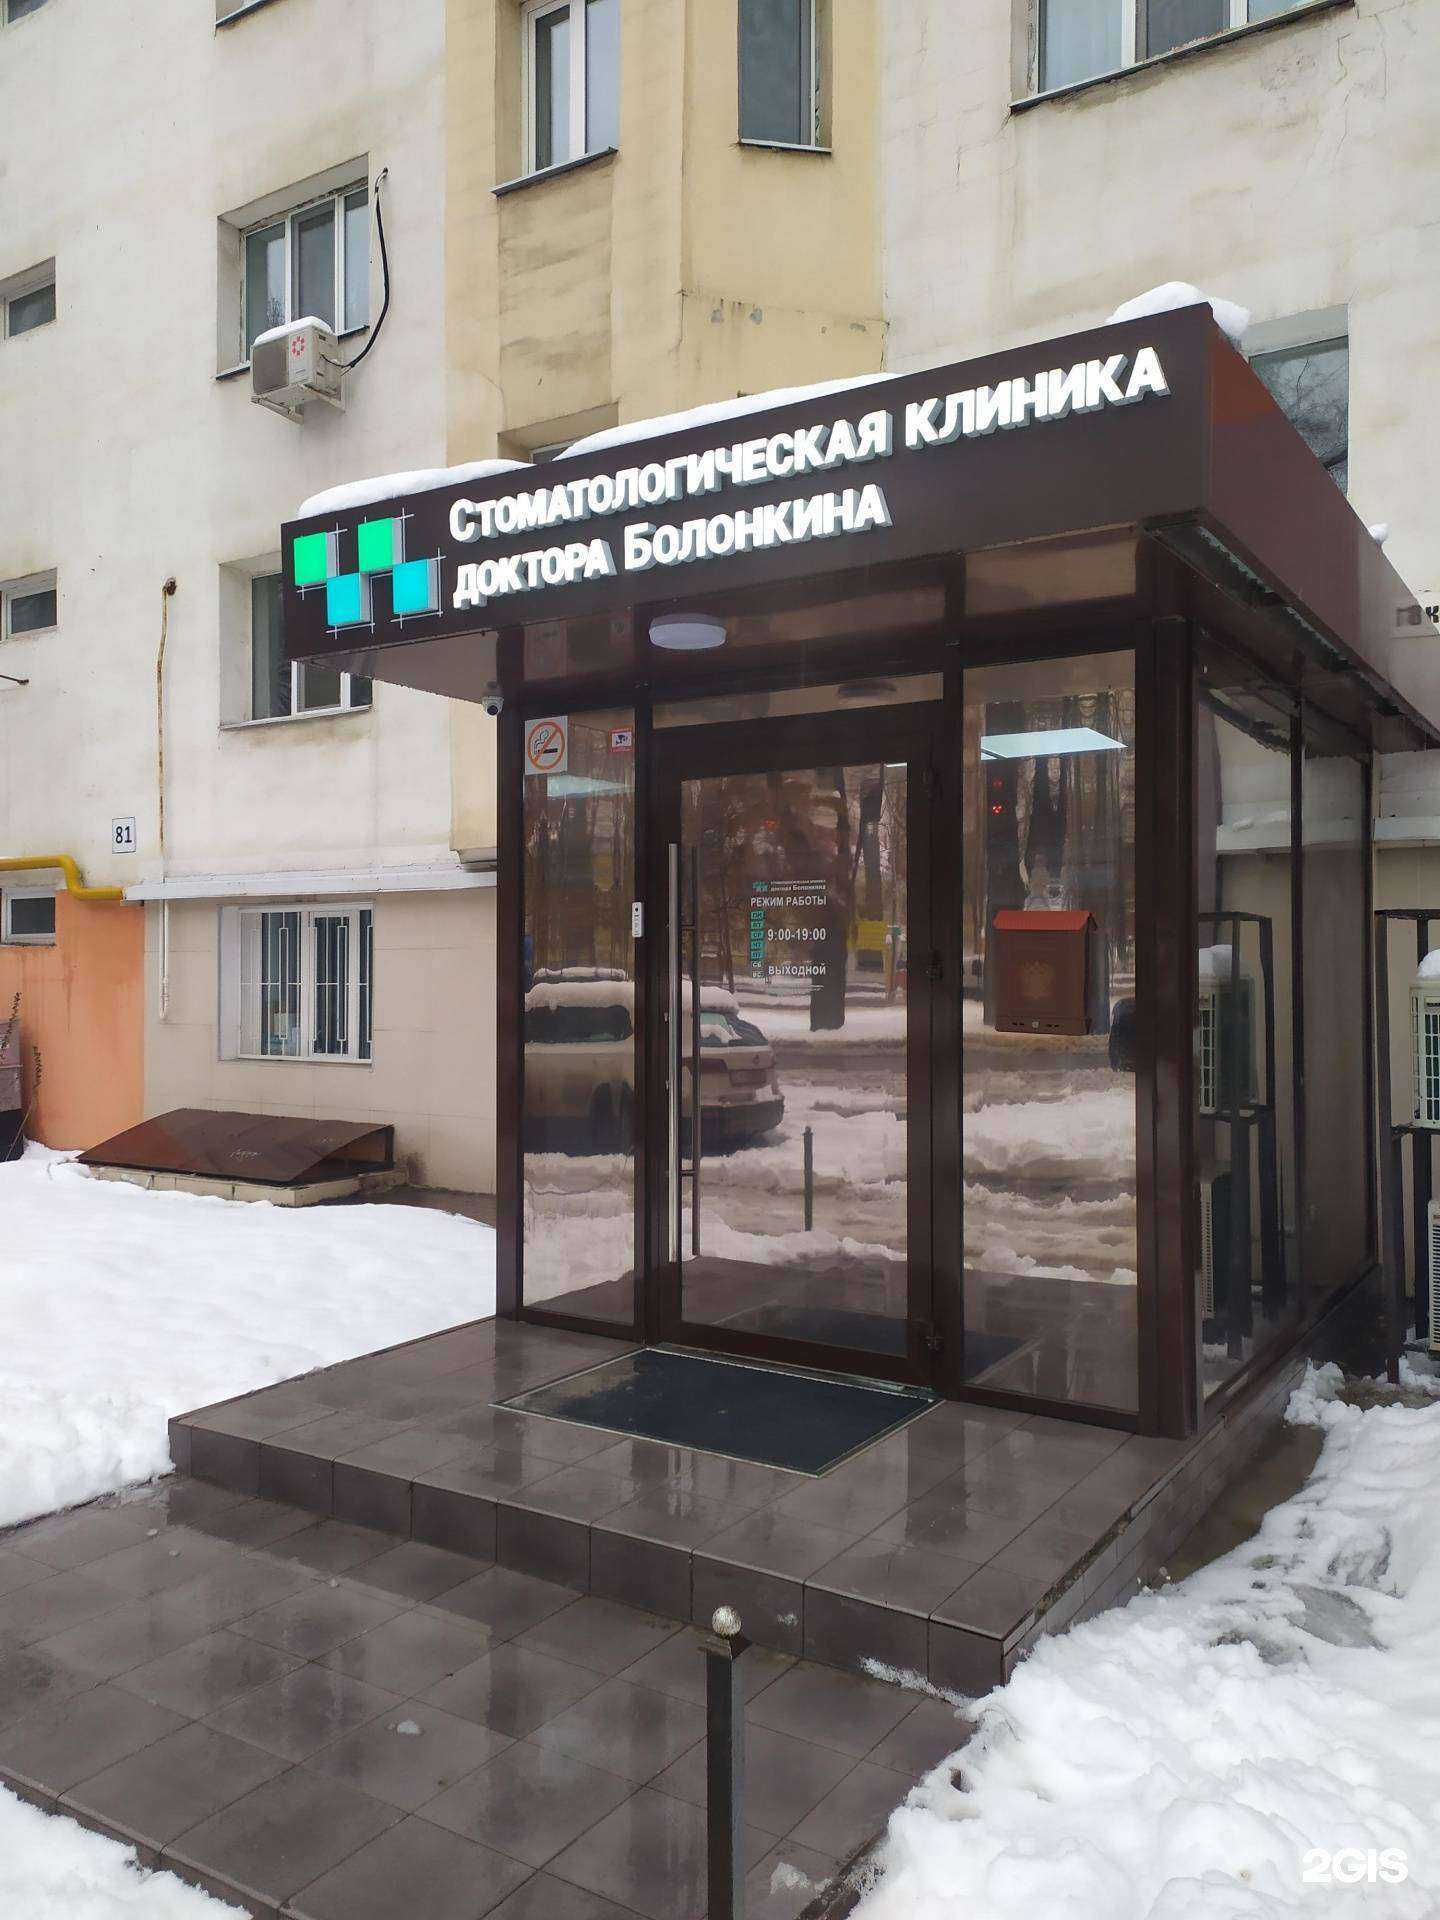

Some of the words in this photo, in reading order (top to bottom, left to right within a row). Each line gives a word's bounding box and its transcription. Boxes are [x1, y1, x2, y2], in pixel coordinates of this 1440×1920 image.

[905, 346, 1170, 449] КЛИНИКА
[115, 825, 133, 844] 81
[750, 896, 784, 907] РЕЖИМ
[786, 895, 827, 907] РАБОТЫ
[767, 928, 826, 941] 9:00-19:00
